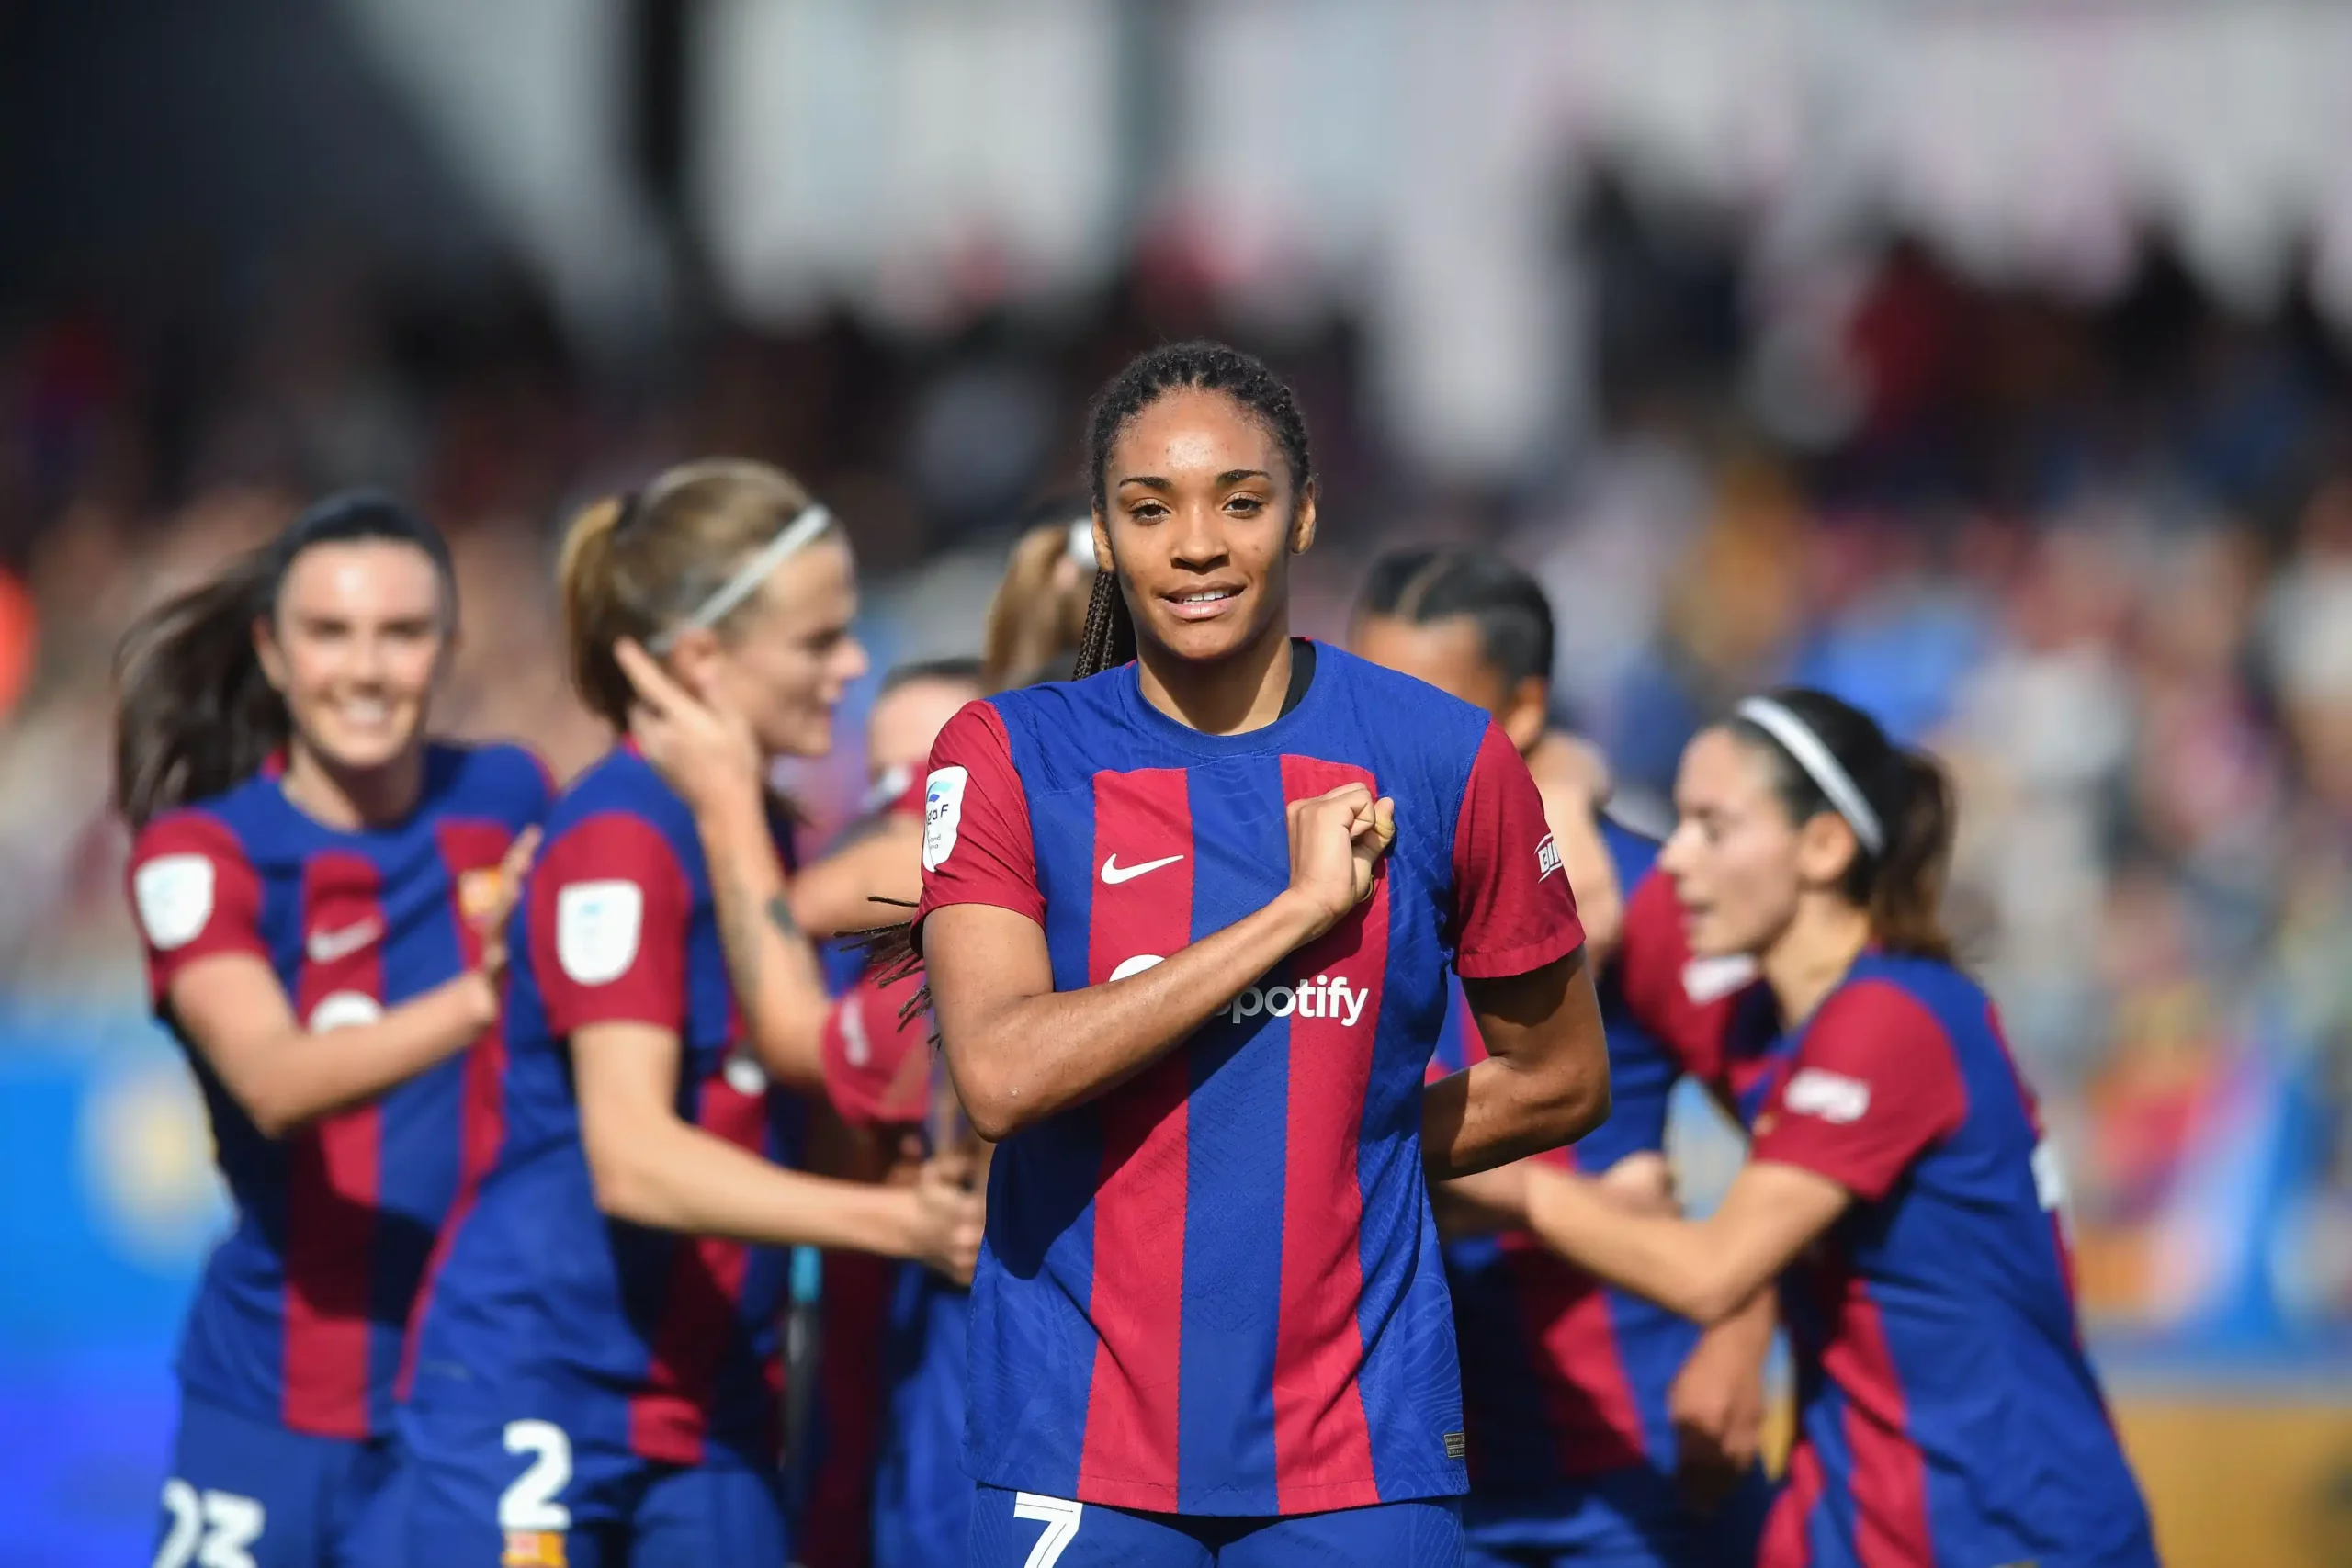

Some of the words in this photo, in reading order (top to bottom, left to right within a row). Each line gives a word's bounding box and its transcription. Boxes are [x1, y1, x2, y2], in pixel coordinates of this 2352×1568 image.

[940, 803, 949, 818] F
[498, 1418, 573, 1530] 2
[1013, 1491, 1083, 1568] 7
